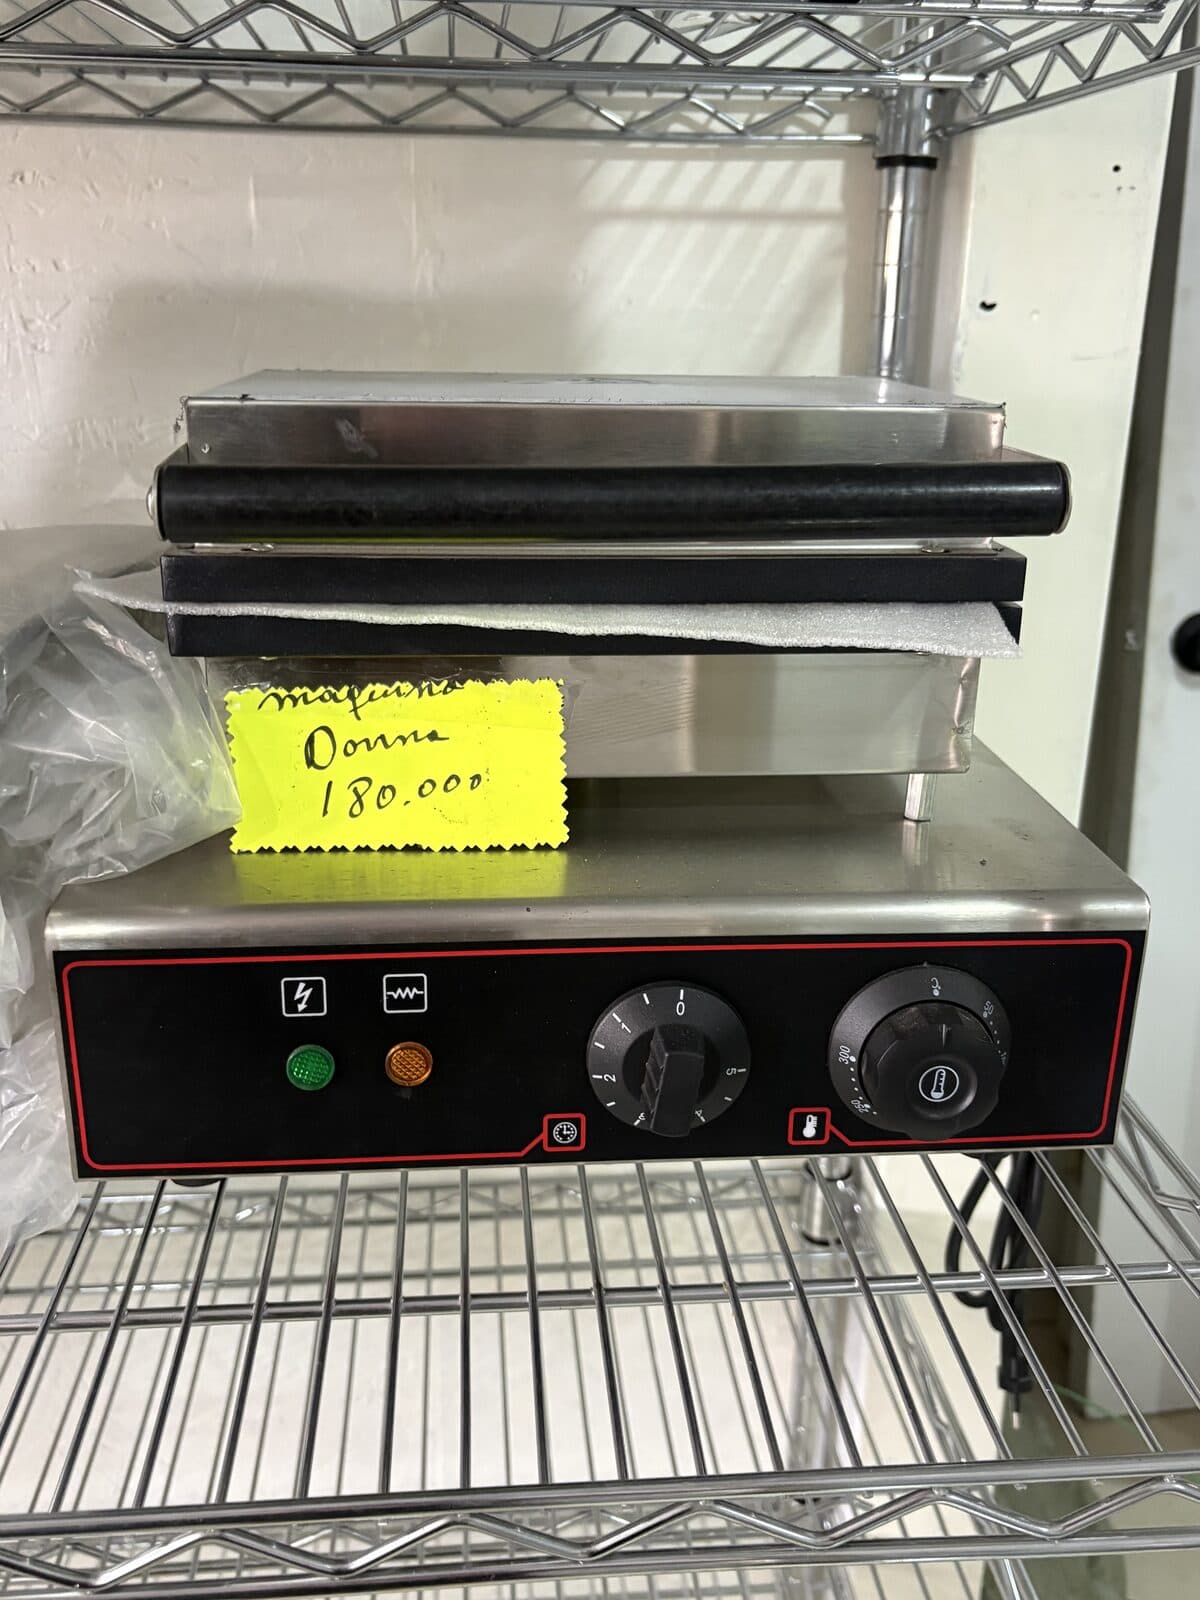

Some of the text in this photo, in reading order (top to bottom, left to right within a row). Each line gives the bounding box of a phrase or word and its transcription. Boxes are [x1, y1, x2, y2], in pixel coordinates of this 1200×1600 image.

[322, 773, 483, 819] 180.000
[676, 1000, 686, 1016] 0
[621, 1022, 632, 1034] 1
[838, 1045, 851, 1065] 300
[603, 1073, 617, 1083] 2
[725, 1067, 737, 1076] 5
